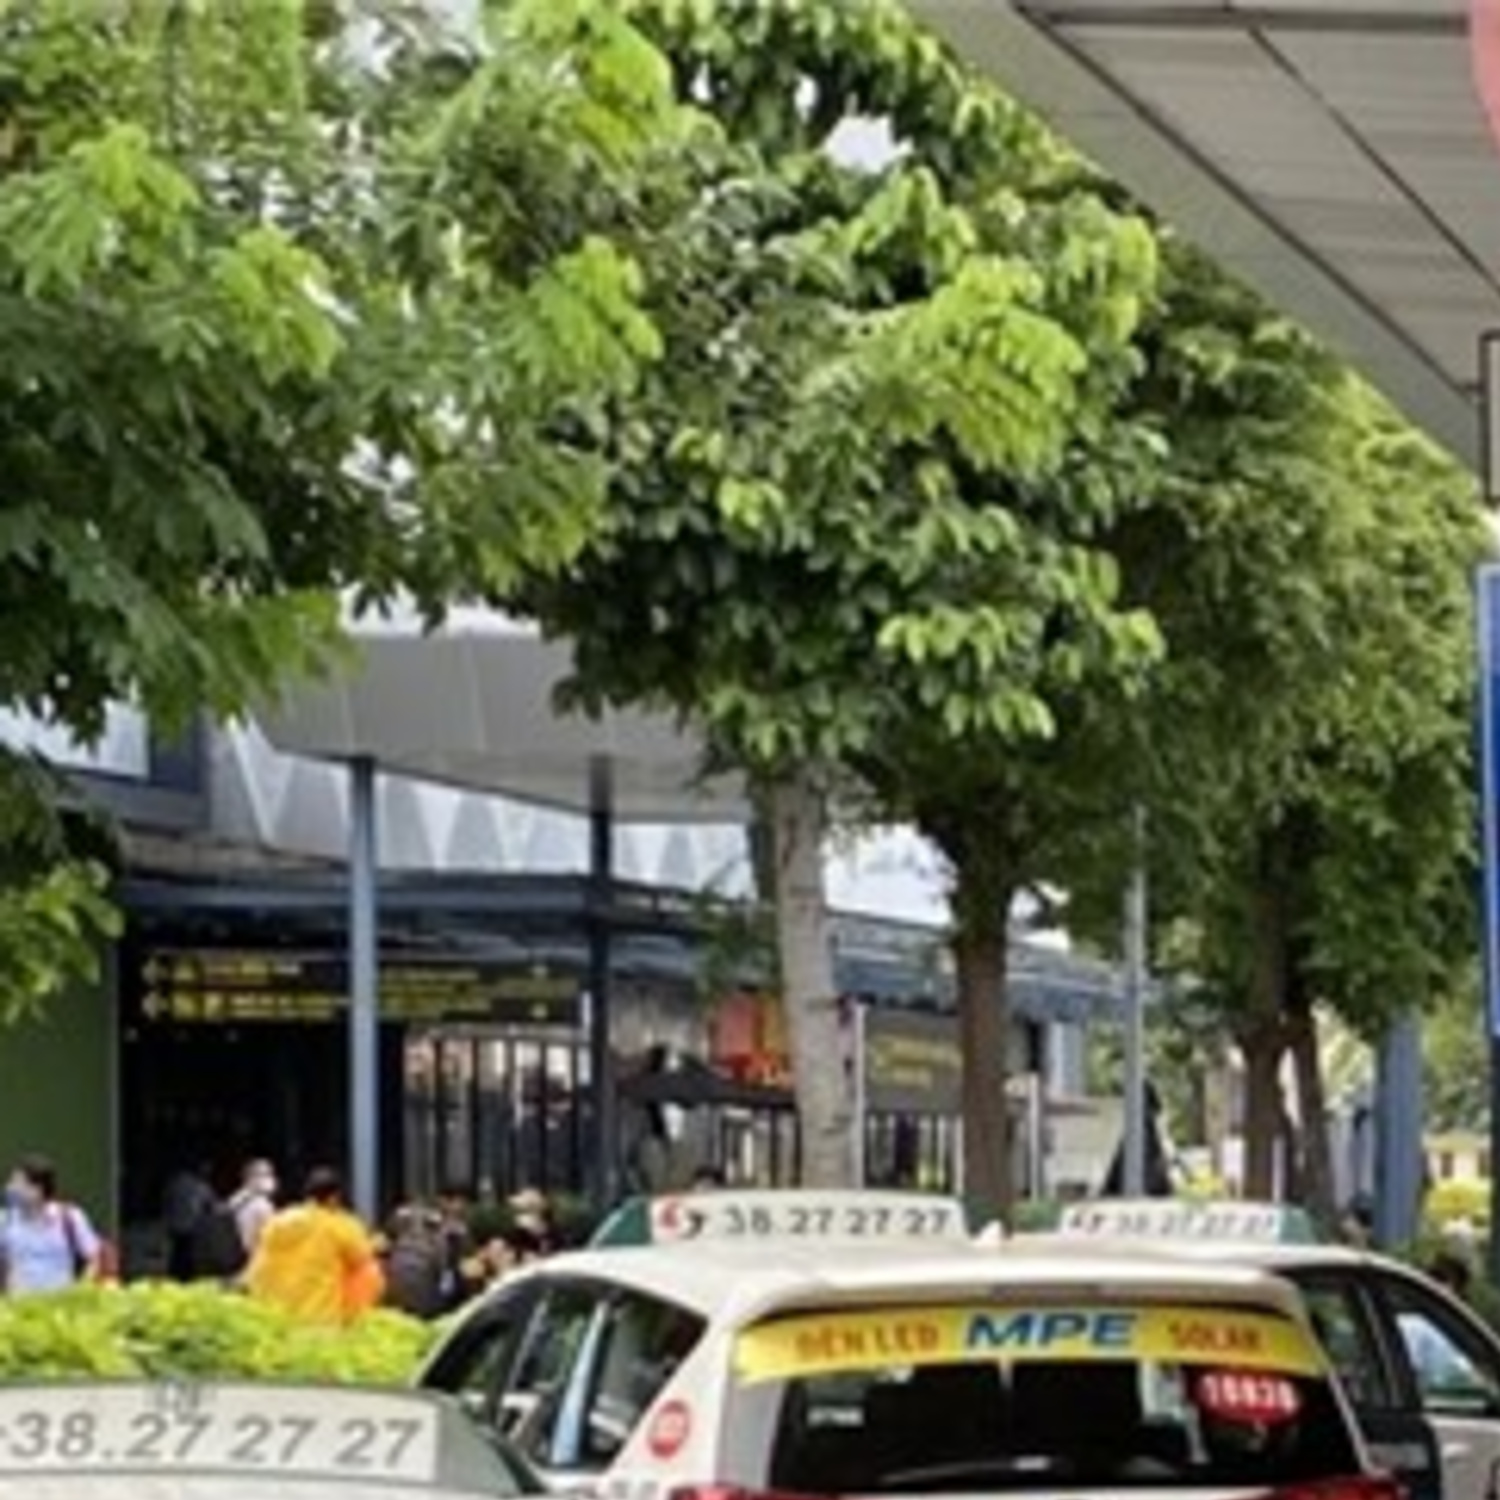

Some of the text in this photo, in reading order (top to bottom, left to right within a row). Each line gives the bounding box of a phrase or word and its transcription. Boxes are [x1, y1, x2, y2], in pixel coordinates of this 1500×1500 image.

[845, 1206, 892, 1236] 27
[903, 1206, 952, 1236] 27
[966, 1313, 1138, 1347] MPE
[229, 1414, 317, 1463] 27
[334, 1417, 424, 1467] 27
